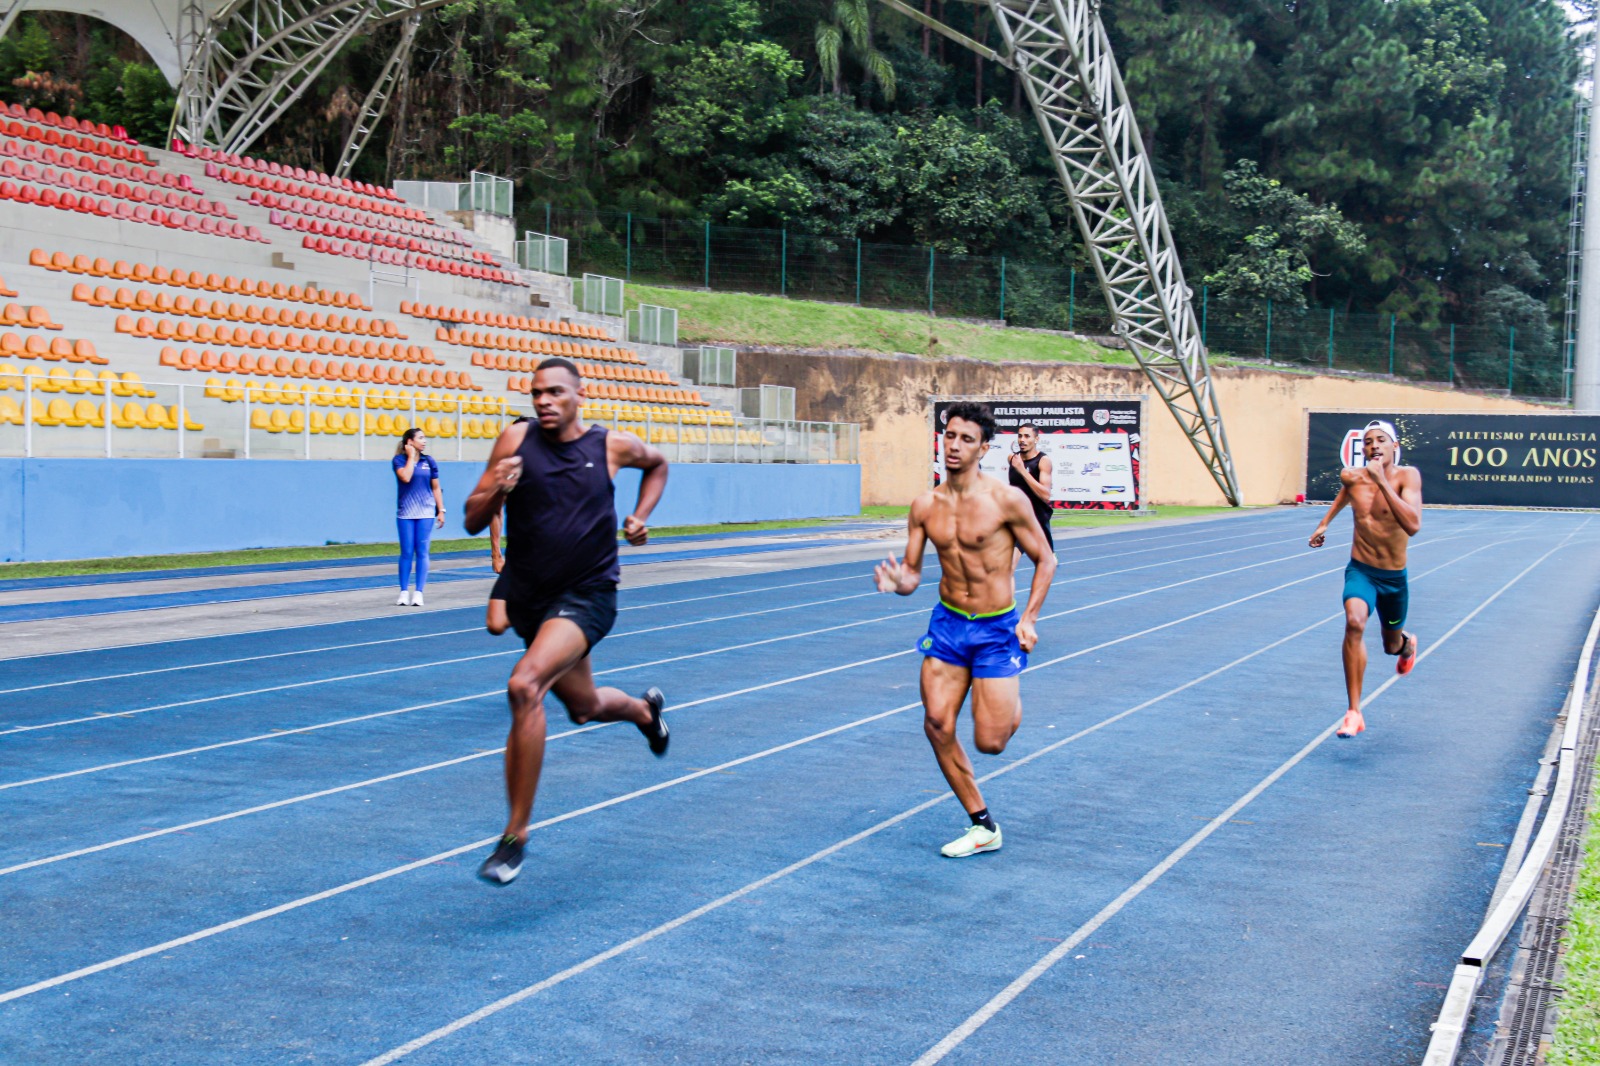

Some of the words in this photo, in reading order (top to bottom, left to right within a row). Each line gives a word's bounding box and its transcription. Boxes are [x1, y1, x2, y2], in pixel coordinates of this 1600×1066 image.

[993, 407, 1042, 415] ATLETISMO
[1043, 407, 1085, 415] PAULISTA
[1031, 417, 1086, 427] CENTENÁRIO
[1447, 431, 1524, 441] ATLETISMO
[1529, 432, 1597, 442] PAULISTA
[1447, 446, 1508, 467] 100
[1521, 447, 1597, 468] ANOS
[1445, 473, 1552, 483] TRANSFORMANDO
[1557, 475, 1594, 484] VIDAS
